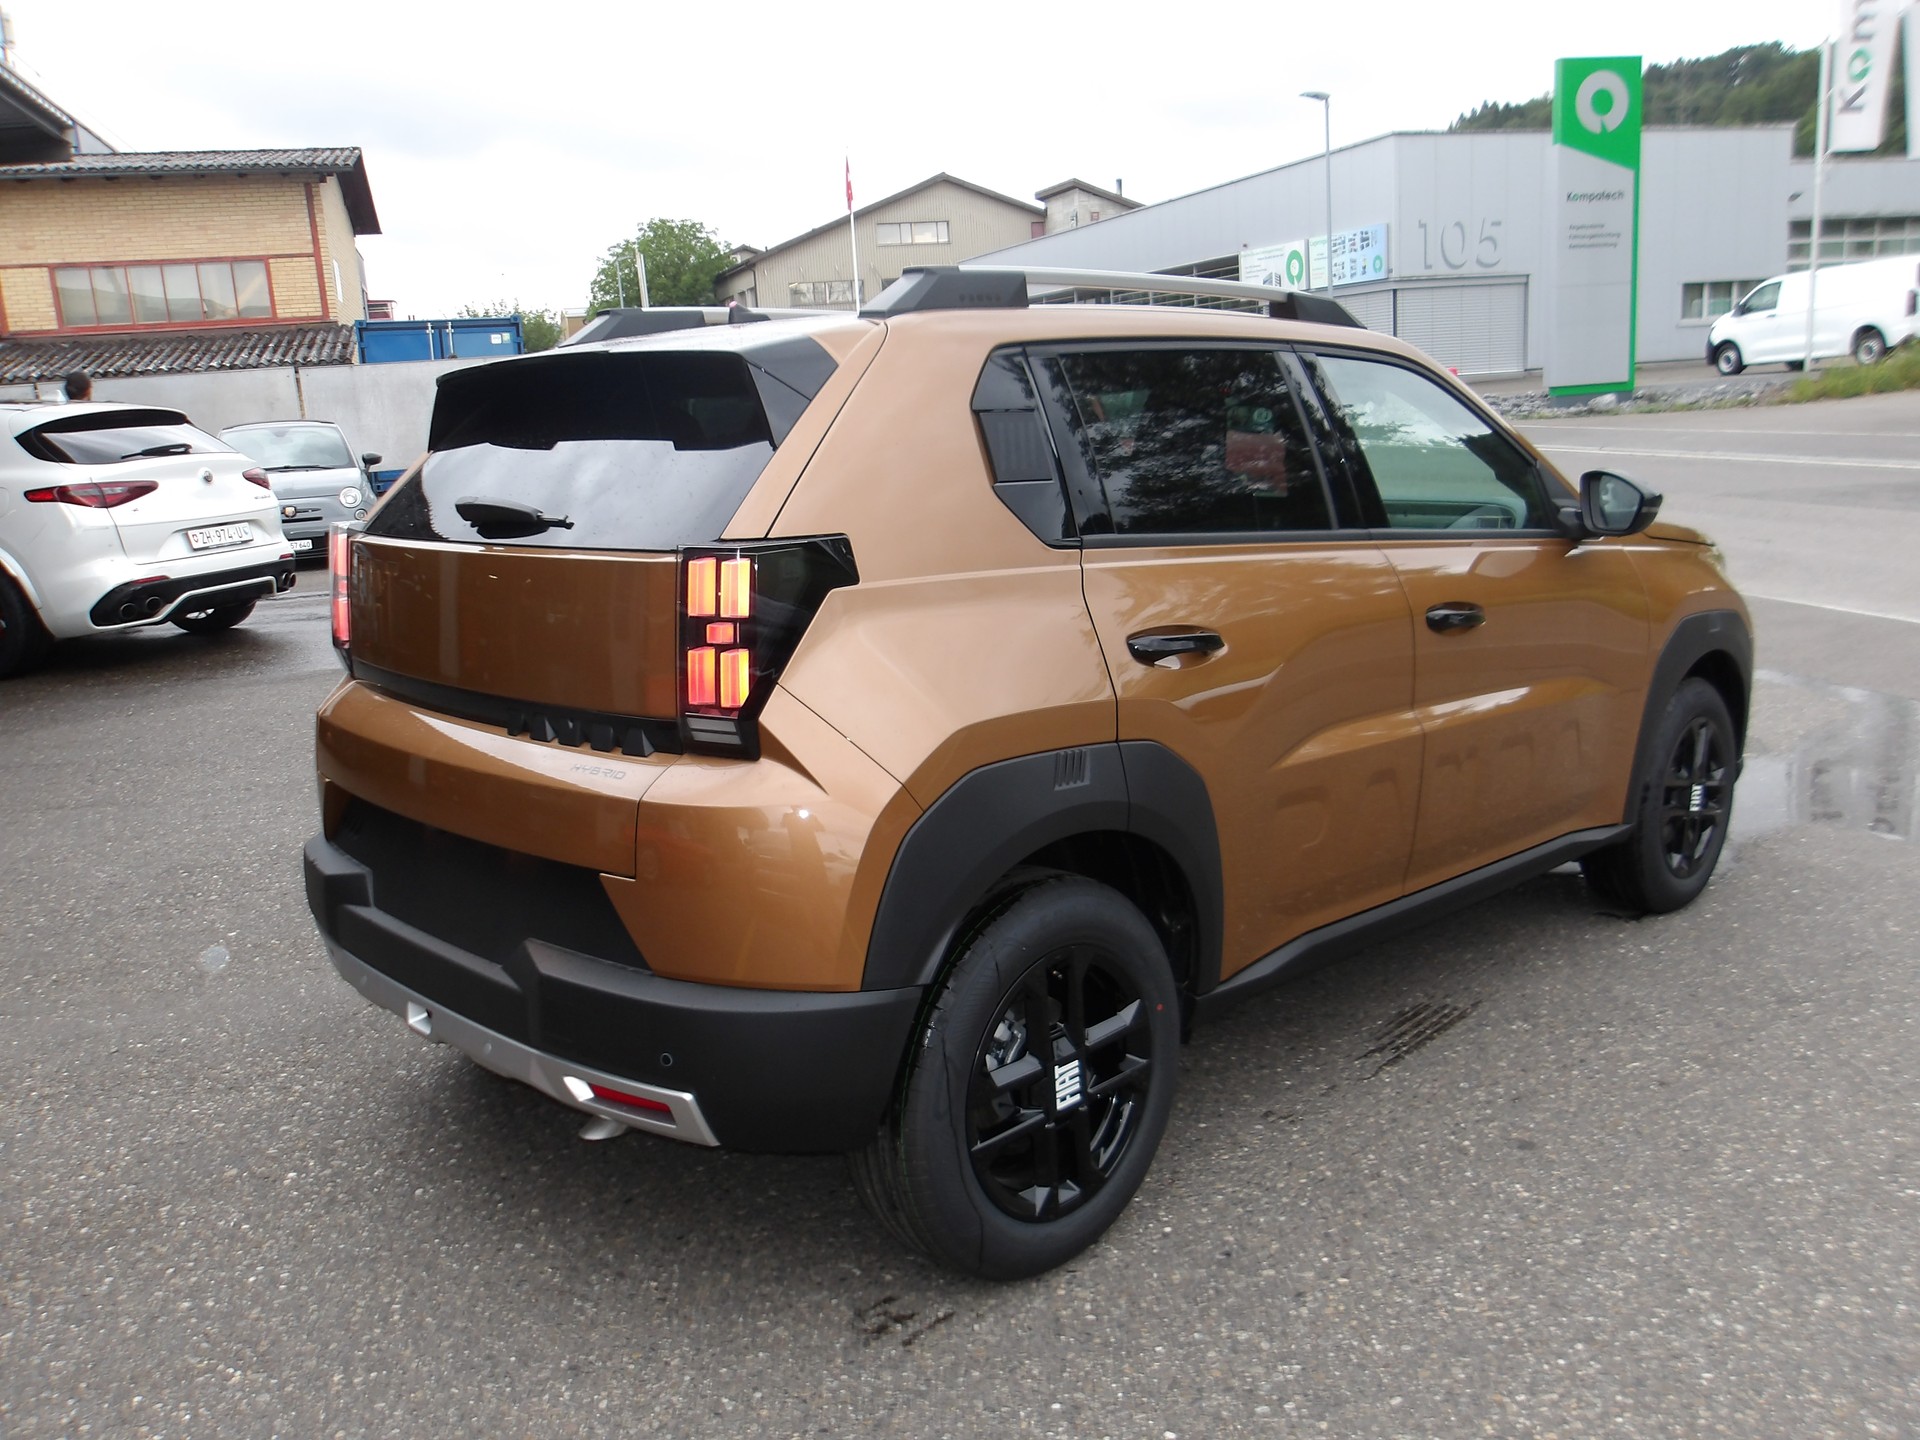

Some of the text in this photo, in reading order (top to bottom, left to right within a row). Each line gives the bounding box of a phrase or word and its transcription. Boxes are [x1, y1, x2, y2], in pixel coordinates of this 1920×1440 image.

[1566, 189, 1625, 204] Kompatech
[1418, 217, 1503, 270] 105
[570, 763, 627, 780] HYBRID
[1054, 1059, 1081, 1111] FIAT
